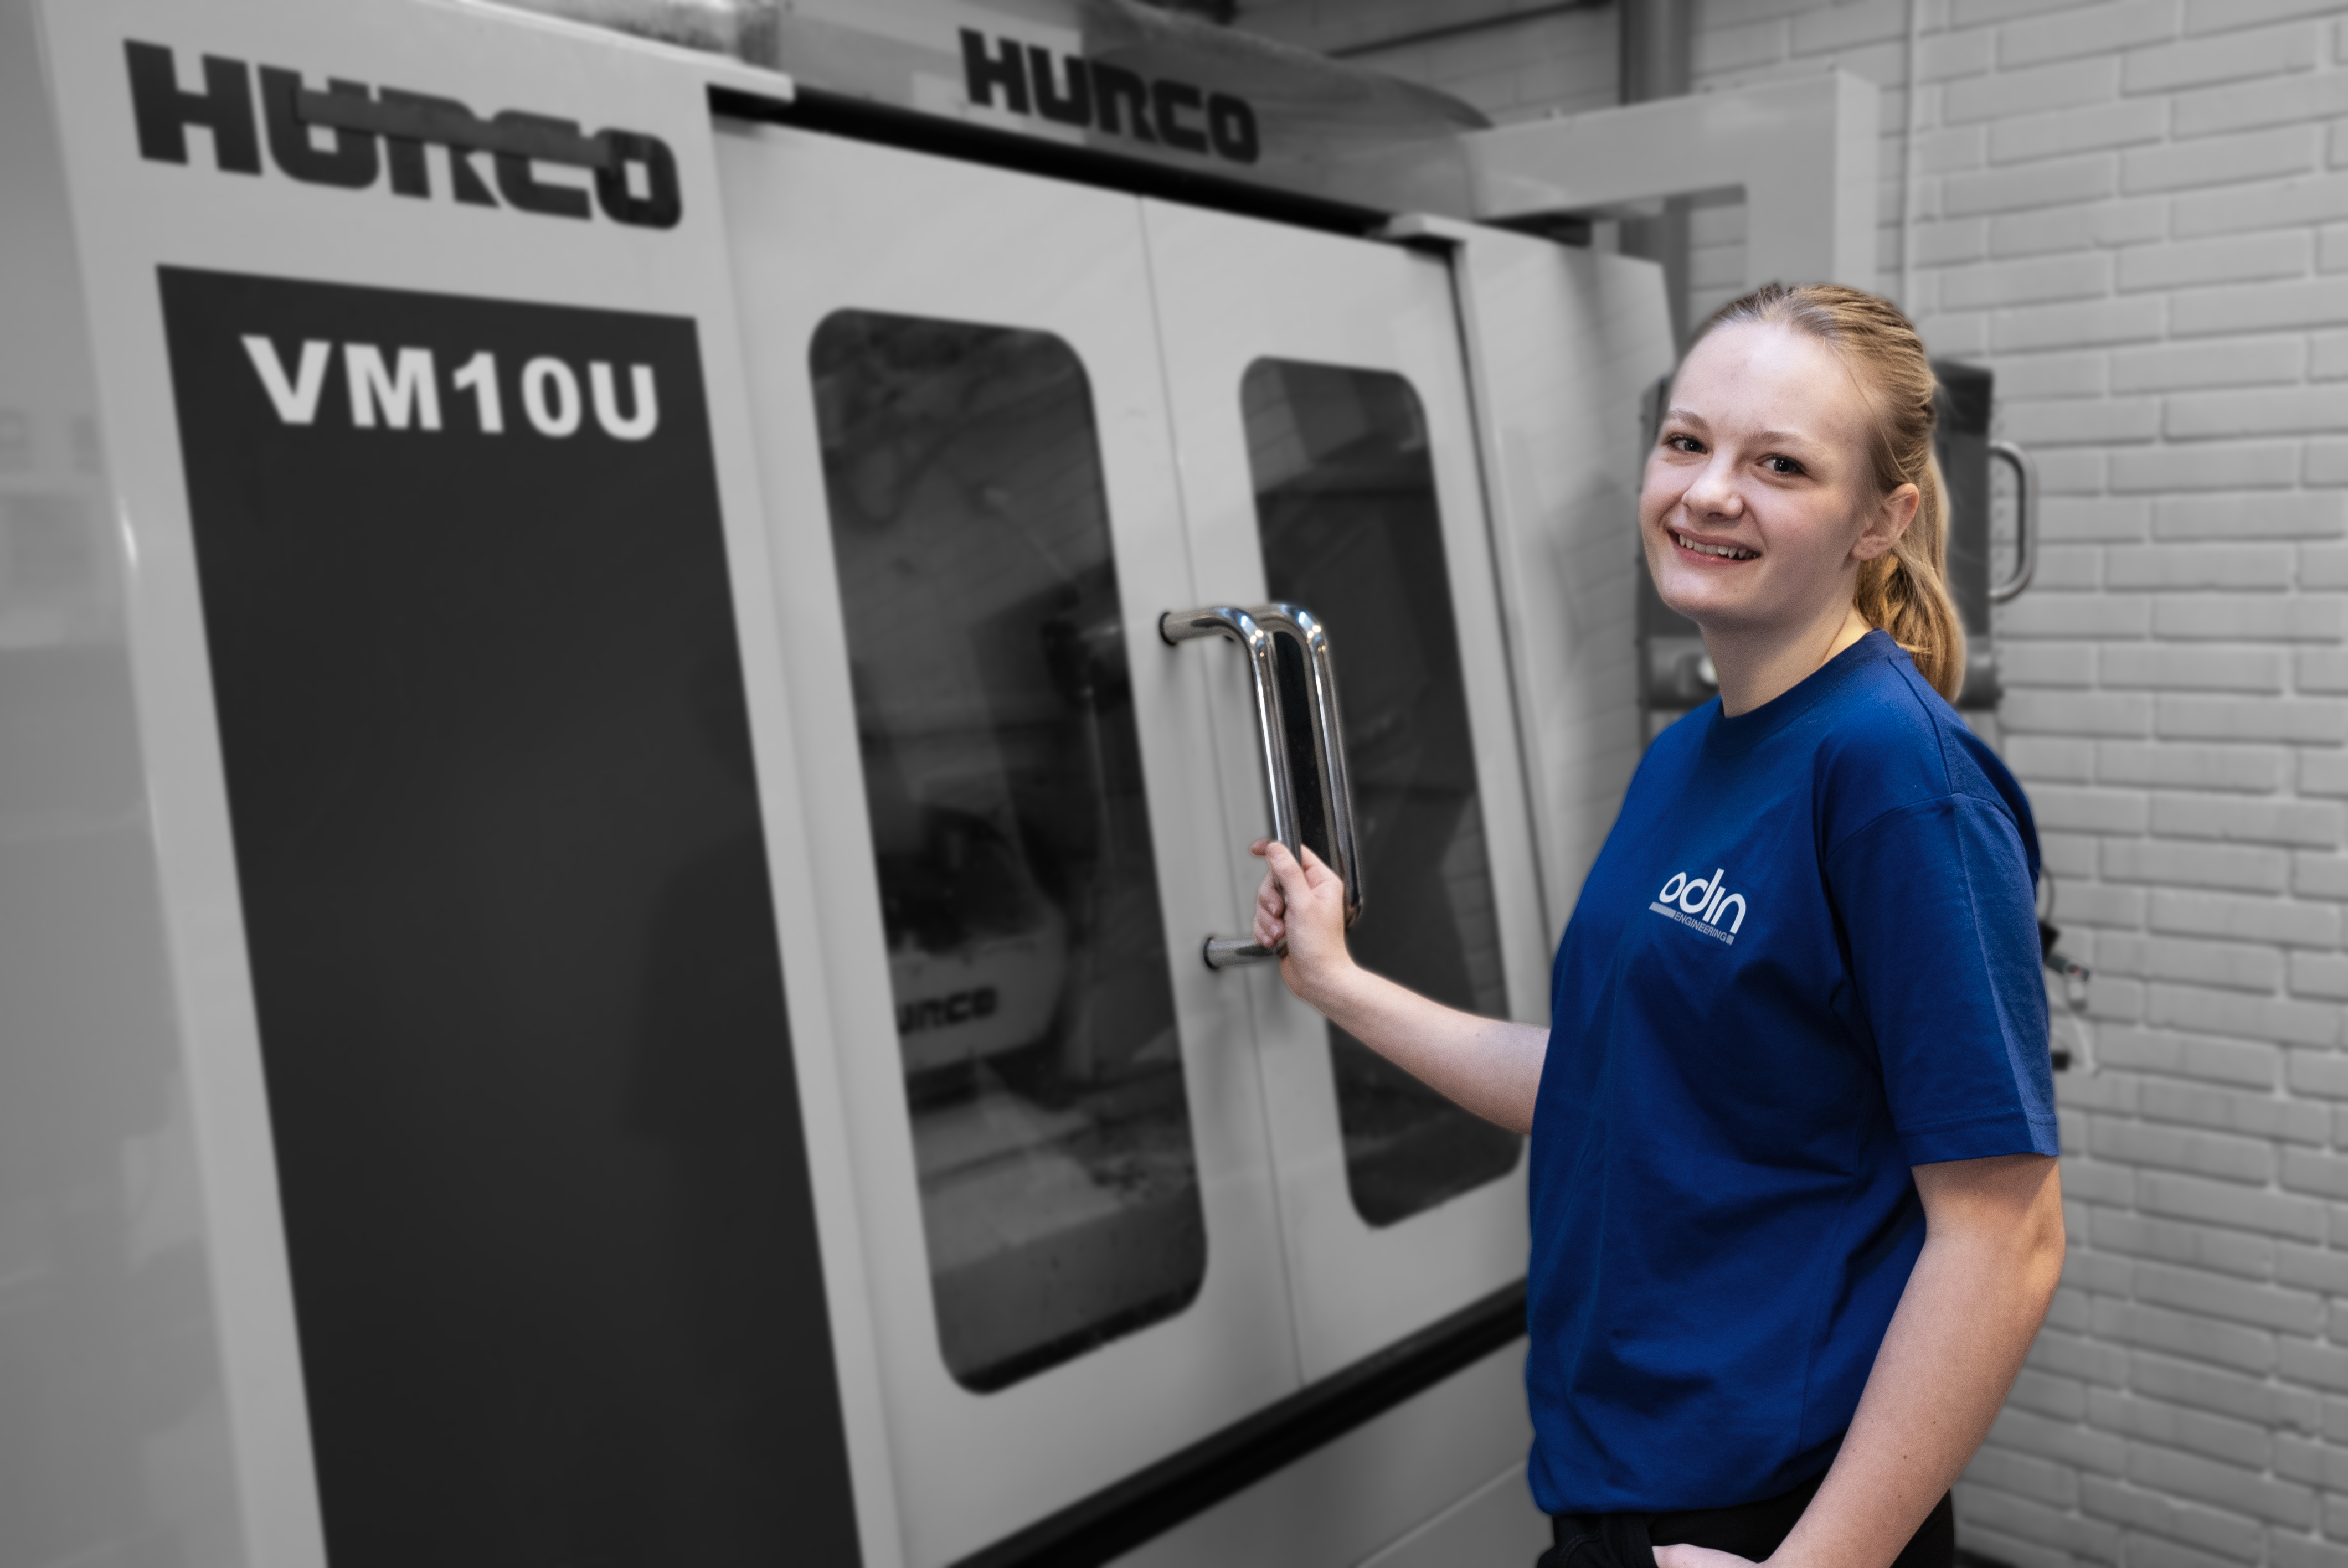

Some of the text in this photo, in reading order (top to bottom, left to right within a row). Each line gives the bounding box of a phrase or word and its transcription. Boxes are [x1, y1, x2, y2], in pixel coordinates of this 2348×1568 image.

[123, 38, 682, 230] HURCO
[959, 27, 1260, 165] HURCO
[240, 334, 658, 441] VM10U
[1659, 868, 1746, 934] odin
[1674, 912, 1728, 942] ENGINEERING
